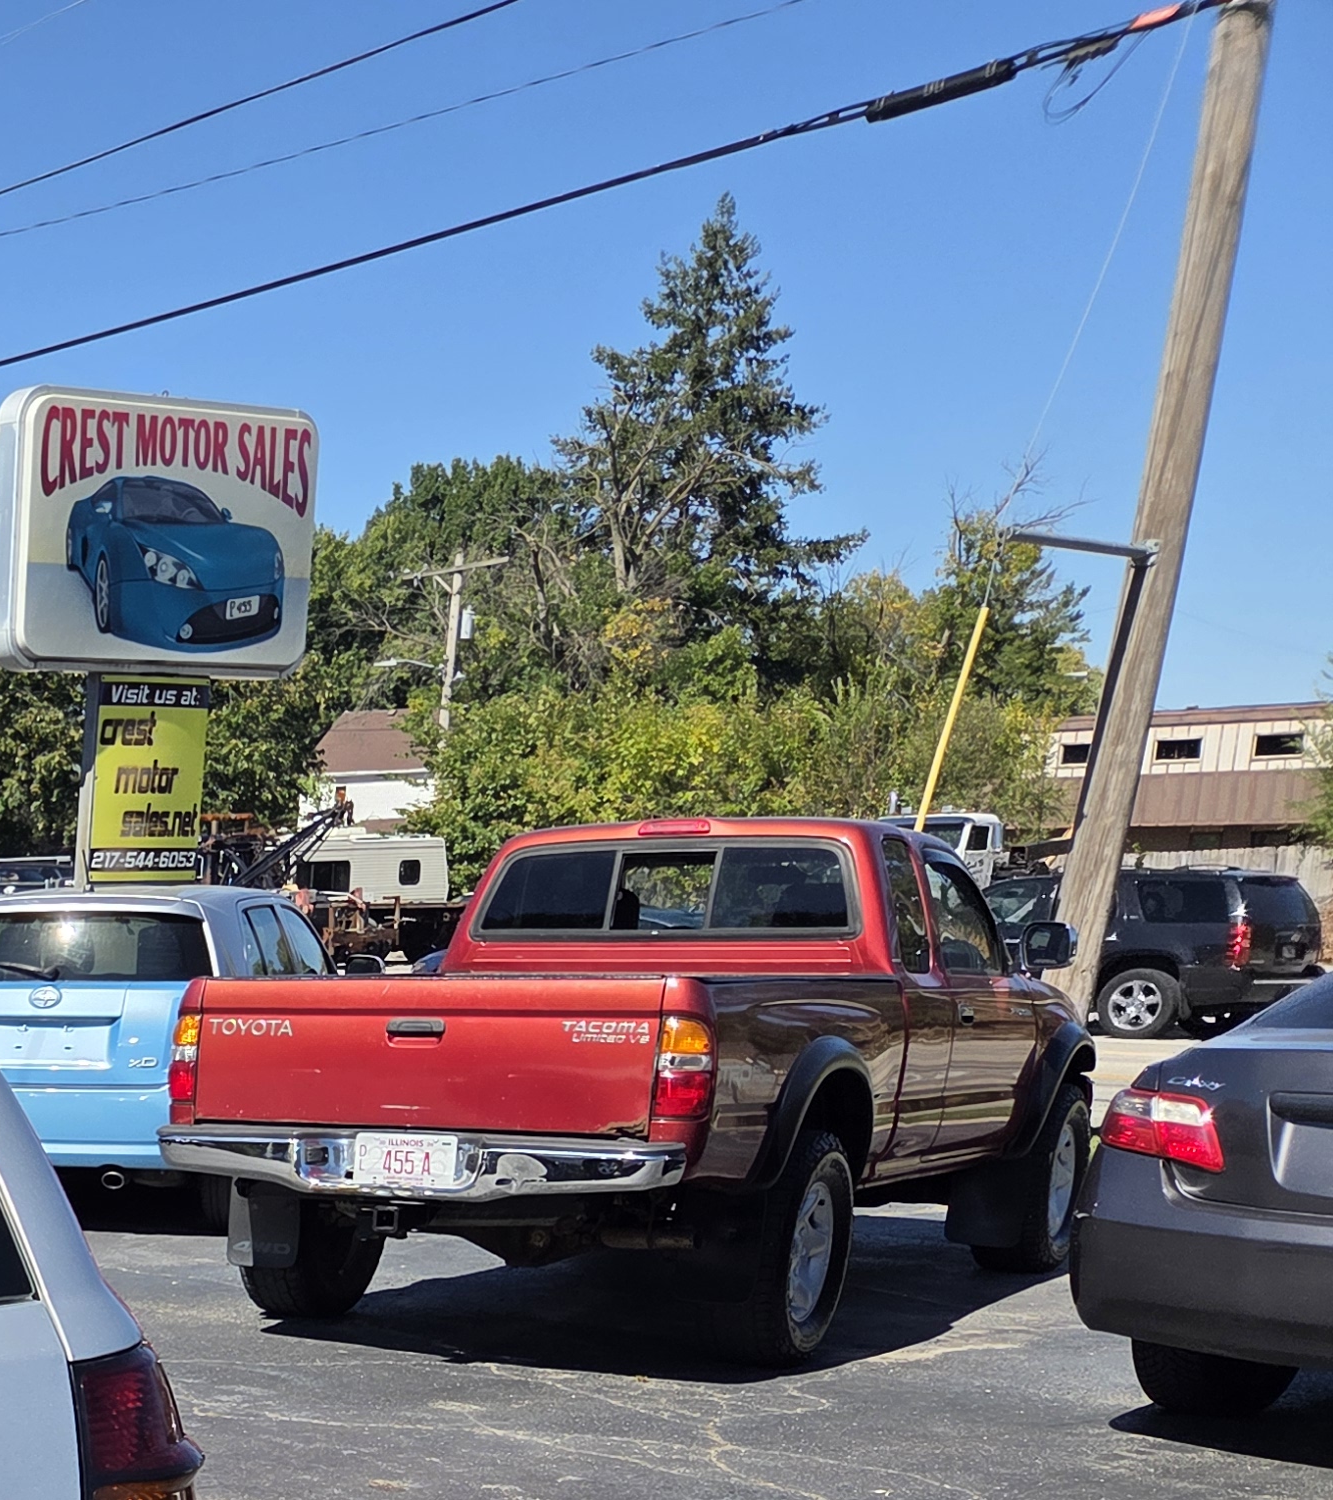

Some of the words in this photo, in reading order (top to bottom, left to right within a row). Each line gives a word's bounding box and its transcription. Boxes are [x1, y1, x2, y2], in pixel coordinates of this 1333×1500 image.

[40, 404, 130, 497] CREST
[135, 413, 230, 476] MOTOR
[236, 422, 312, 518] SALES
[111, 684, 150, 704] Visit
[154, 688, 178, 705] us
[180, 686, 201, 706] at:
[99, 710, 157, 746] crest
[114, 759, 179, 794] motor
[119, 802, 199, 837] sales.net
[90, 851, 196, 869] 217-544-6053
[209, 1018, 293, 1037] TOYOTA
[562, 1020, 650, 1034] TACOMA
[388, 1138, 424, 1148] ILLINOIS
[383, 1150, 415, 1175] 455
[422, 1151, 431, 1175] A
